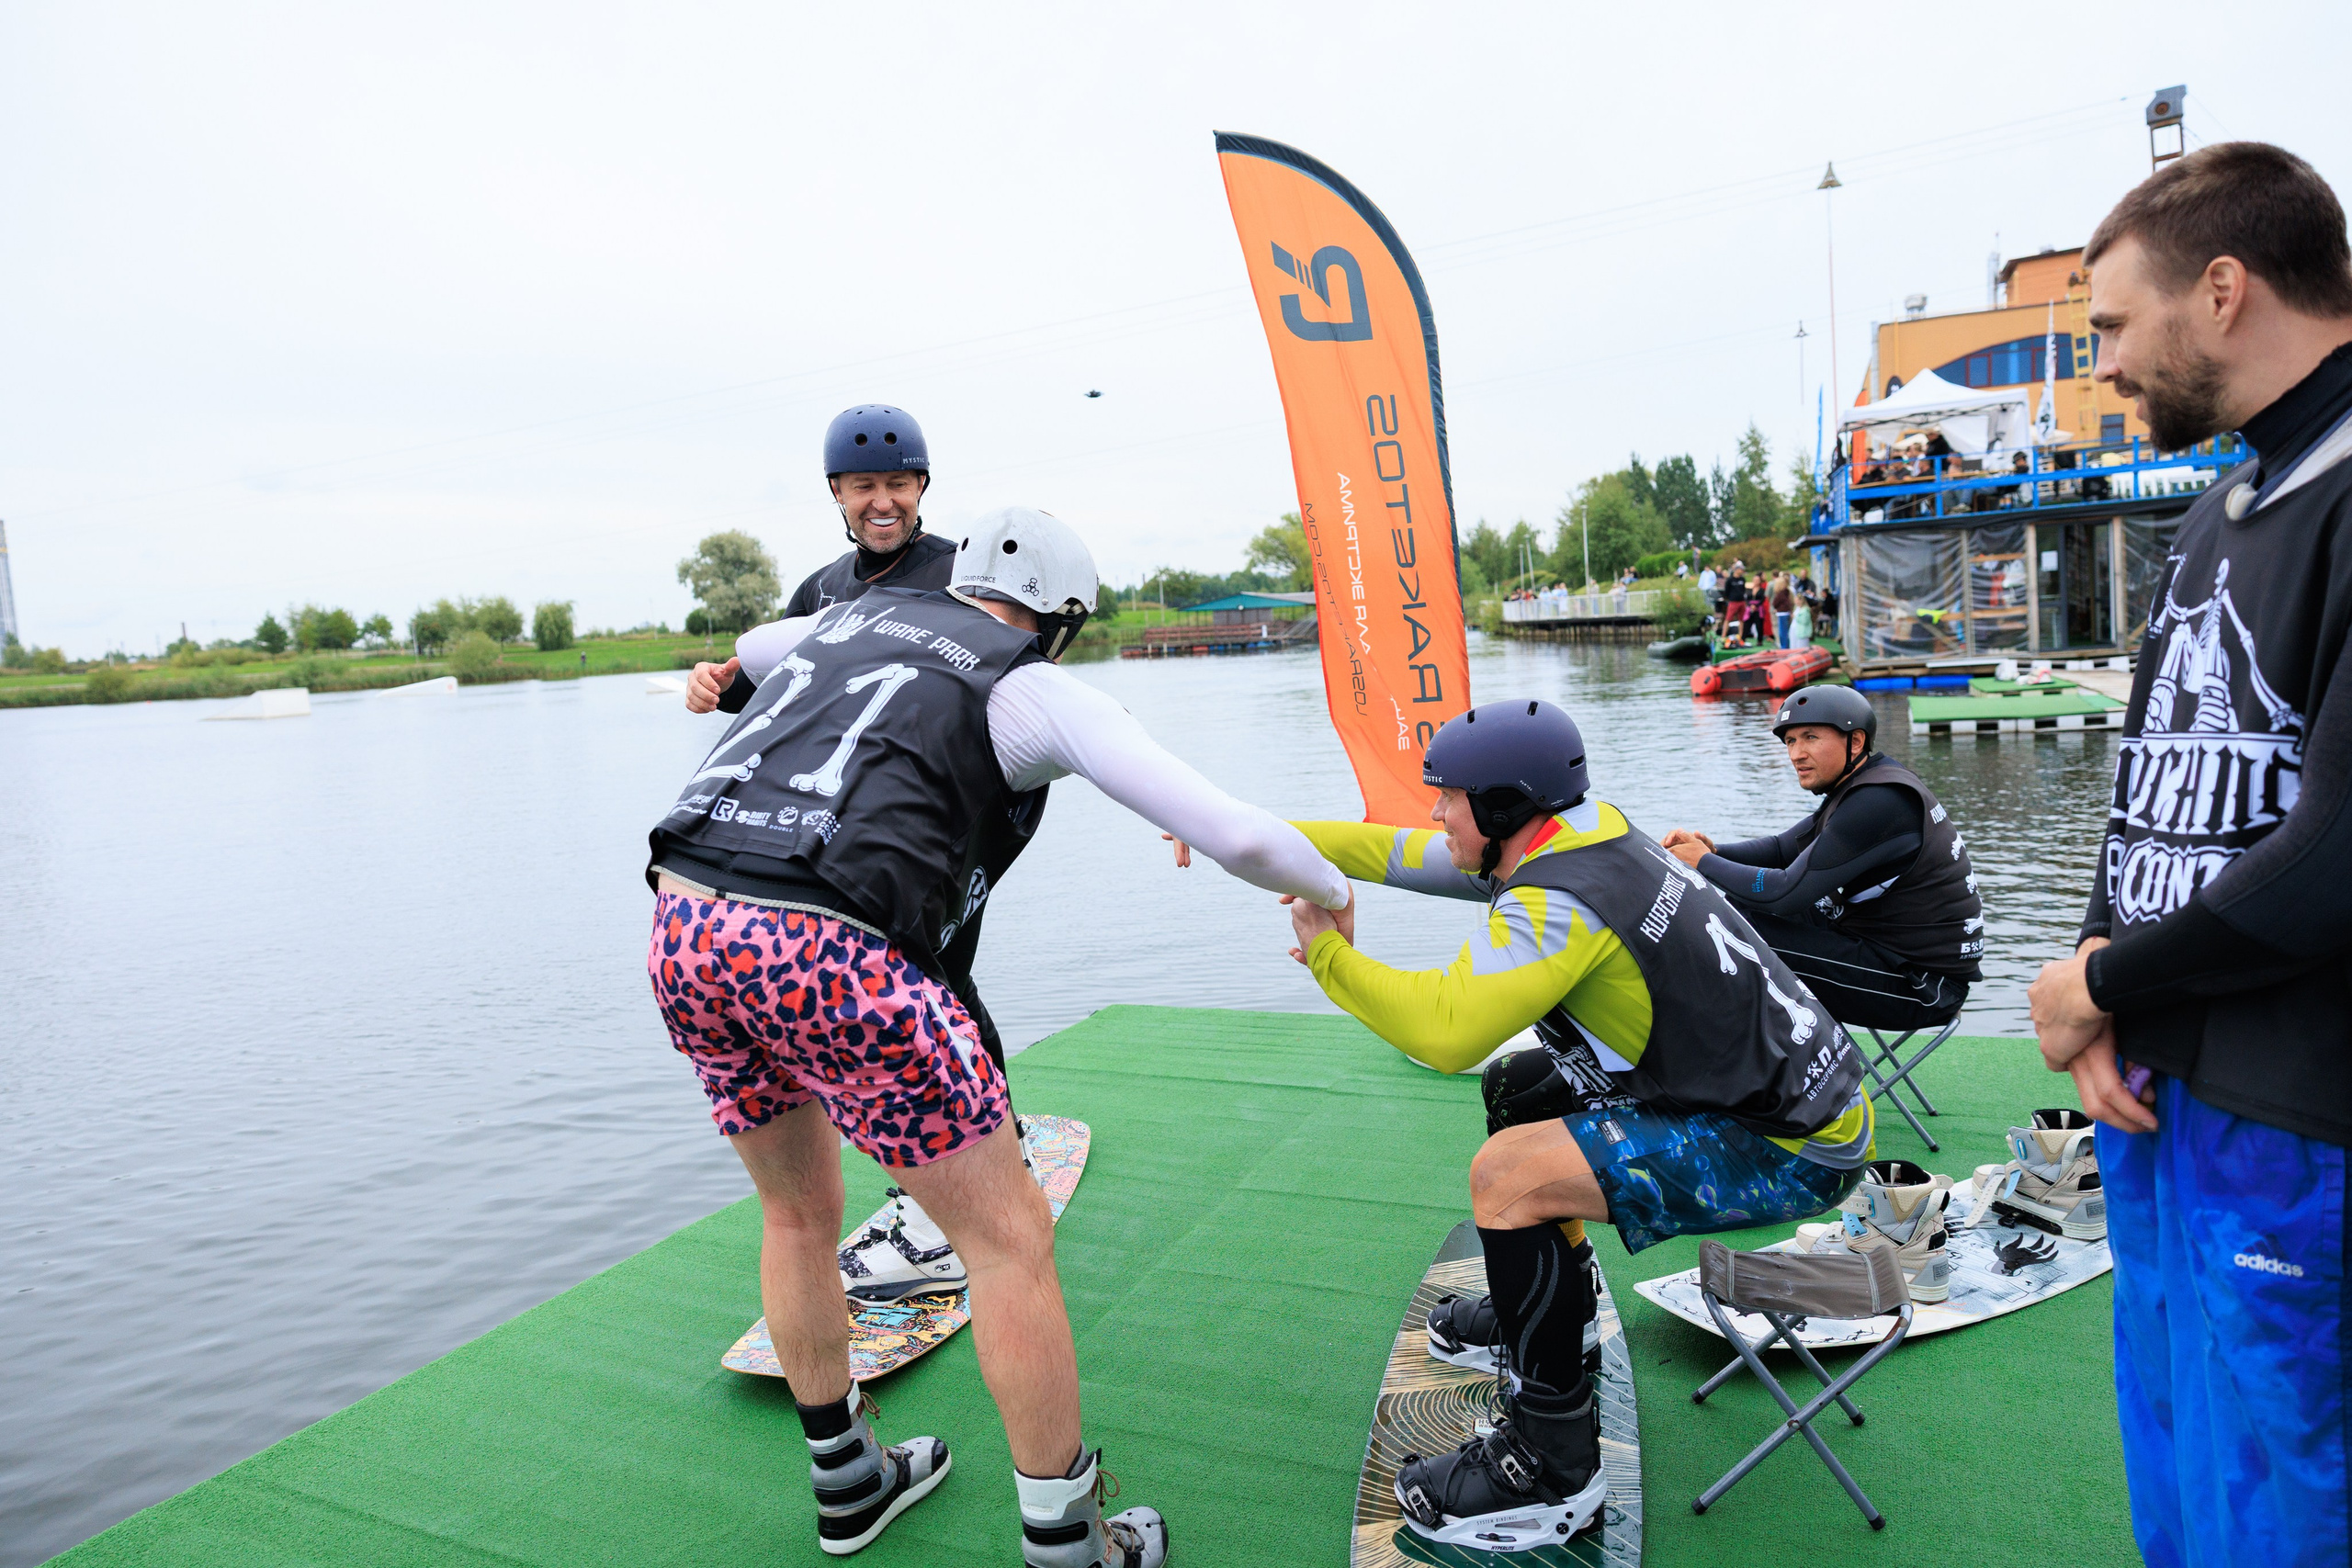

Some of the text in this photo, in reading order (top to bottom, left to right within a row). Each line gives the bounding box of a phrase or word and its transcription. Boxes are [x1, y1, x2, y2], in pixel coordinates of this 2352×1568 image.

[902, 457, 925, 465] MYSTIC
[977, 575, 997, 583] FORCE
[873, 619, 981, 671] WAKE PARK
[749, 811, 773, 820] DIRTY
[768, 824, 794, 833] DOUBLE
[1639, 871, 1687, 943] KUPCHINO
[1806, 1059, 1839, 1102] АВТОСЕРВИС
[2233, 1253, 2304, 1278] adidas
